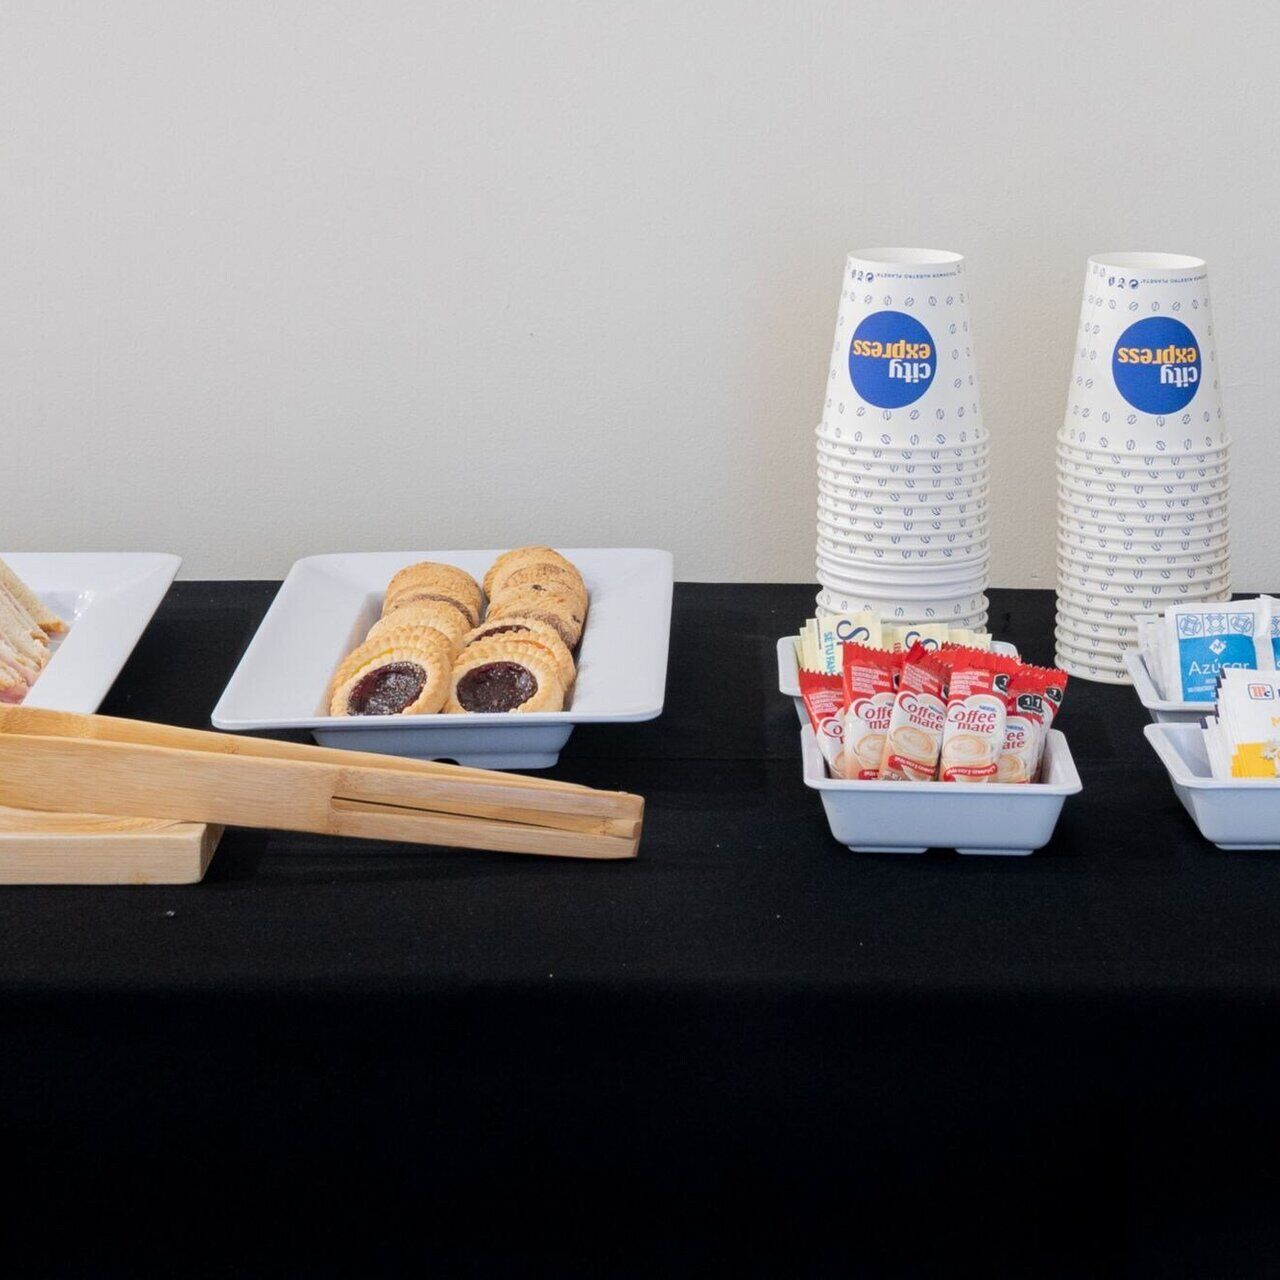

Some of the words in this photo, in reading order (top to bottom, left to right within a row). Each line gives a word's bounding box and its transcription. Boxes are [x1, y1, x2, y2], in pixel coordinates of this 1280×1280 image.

[853, 340, 931, 359] express
[1117, 345, 1197, 364] express
[888, 359, 931, 383] city
[1160, 364, 1198, 388] city
[899, 693, 944, 721] Coffee
[869, 720, 890, 729] ma
[909, 713, 943, 730] mate
[957, 722, 995, 733] mate
[1002, 741, 1025, 750] ate
